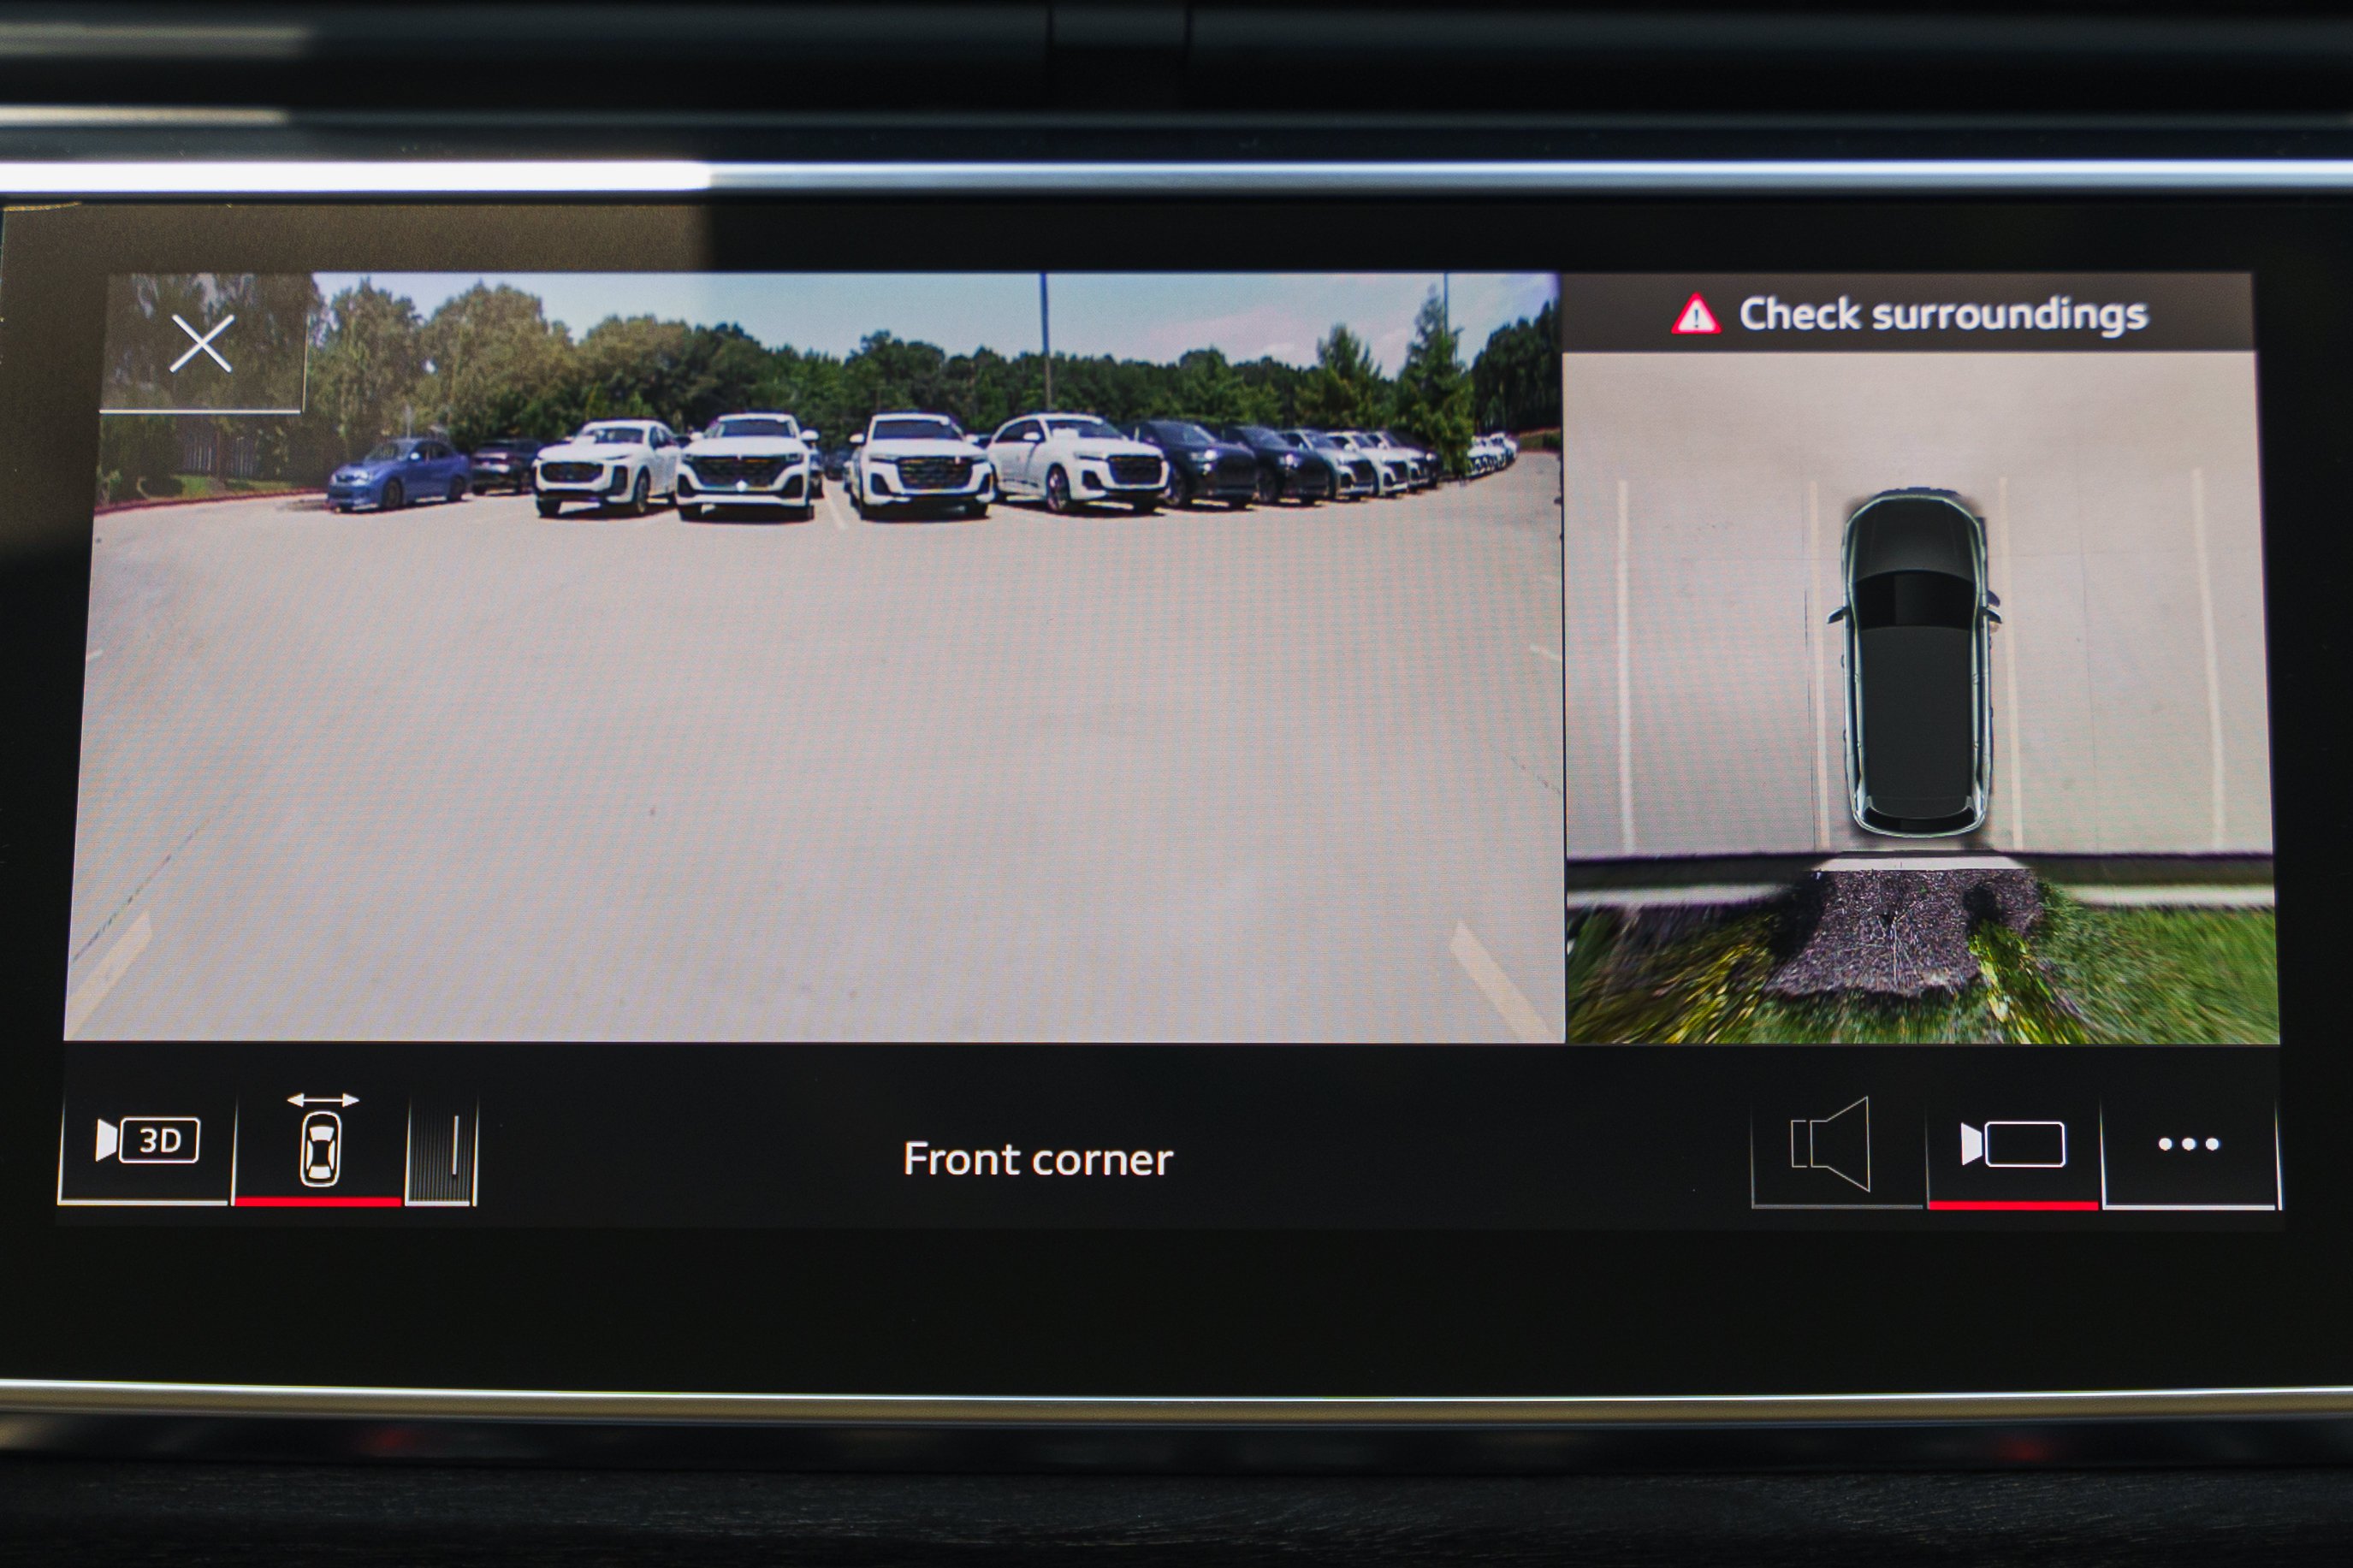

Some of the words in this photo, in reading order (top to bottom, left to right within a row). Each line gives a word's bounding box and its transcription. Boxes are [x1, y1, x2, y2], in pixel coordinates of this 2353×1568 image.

[1740, 296, 1860, 330] Check
[1871, 296, 2149, 338] surroundings
[139, 1127, 182, 1154] 3D
[904, 1141, 1021, 1175] Front
[1032, 1150, 1174, 1175] corner
